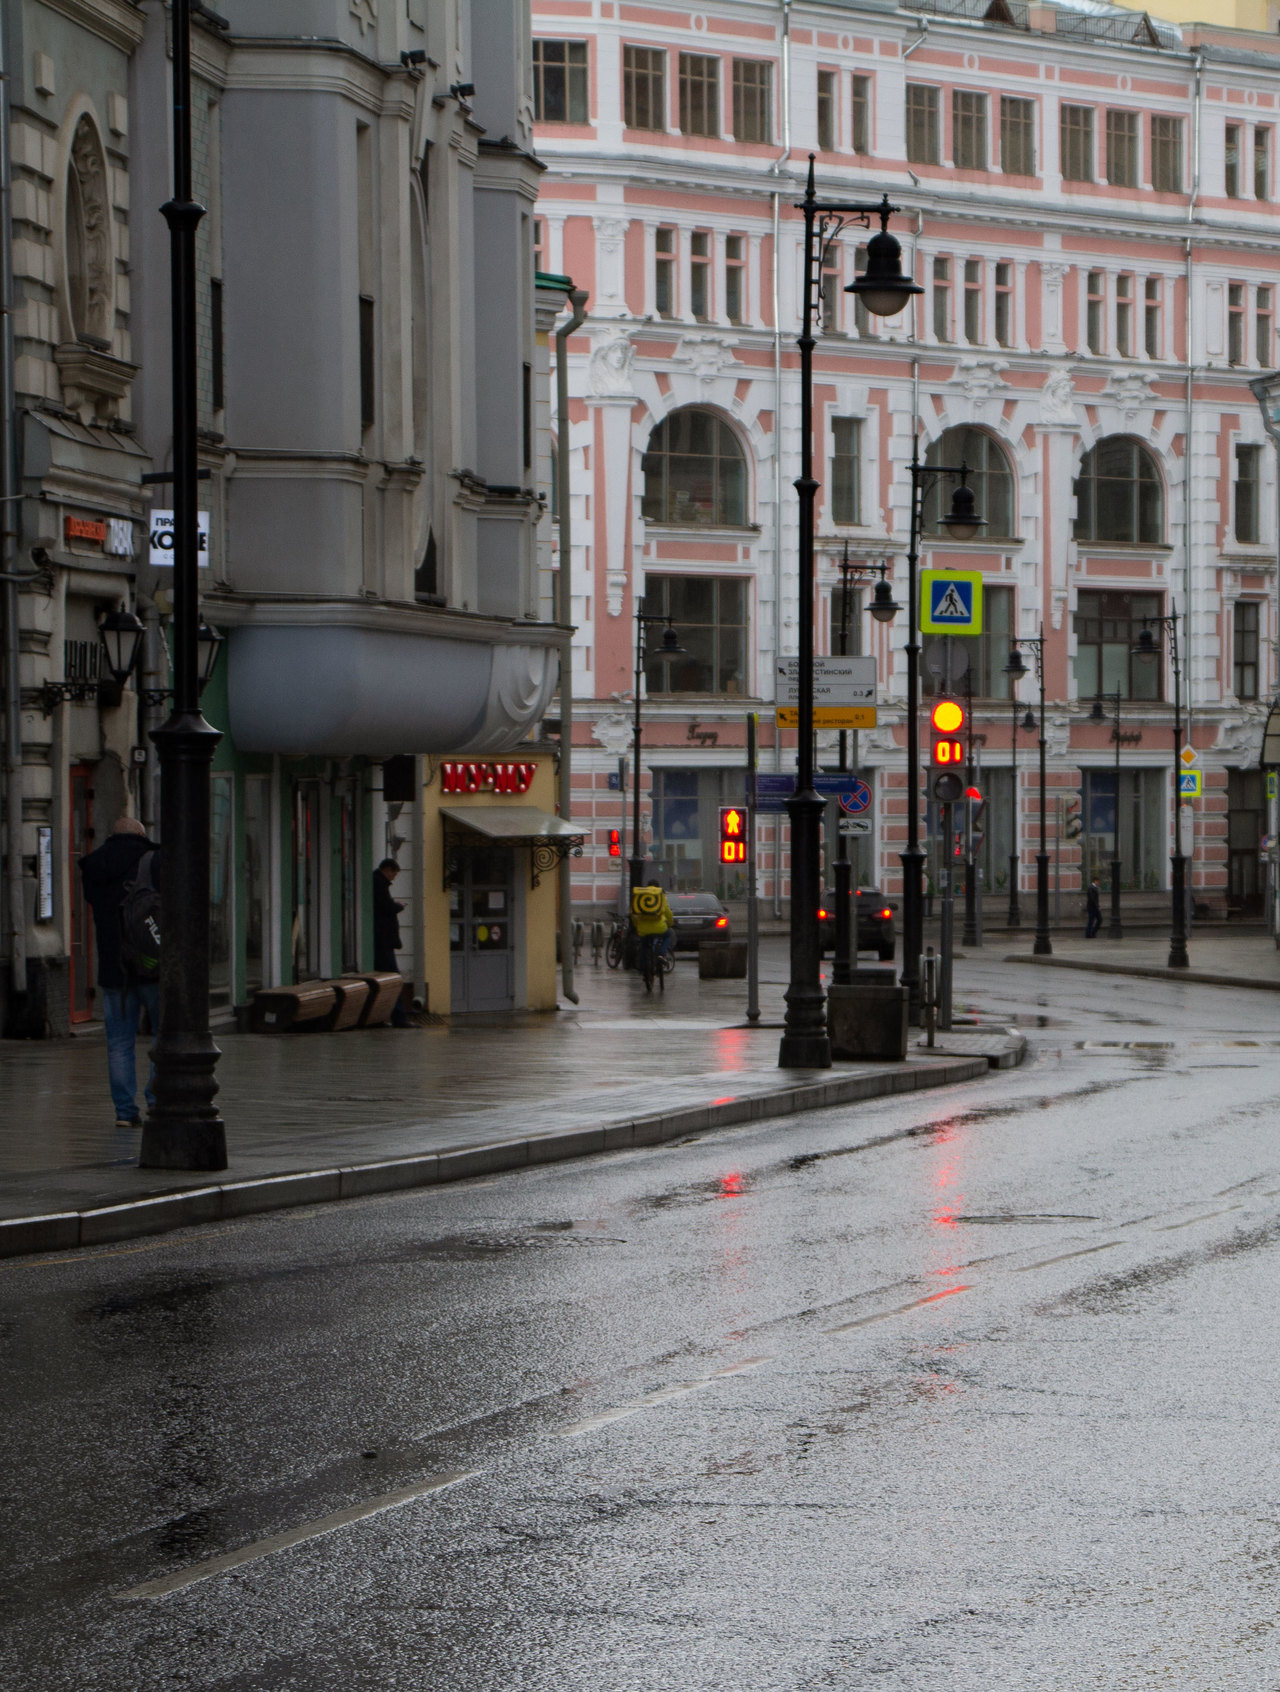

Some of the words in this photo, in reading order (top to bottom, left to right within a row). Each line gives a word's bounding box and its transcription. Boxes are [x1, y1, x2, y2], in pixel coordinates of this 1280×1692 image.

[150, 530, 206, 551] КОЕ
[935, 740, 962, 765] 01
[722, 840, 745, 863] 01
